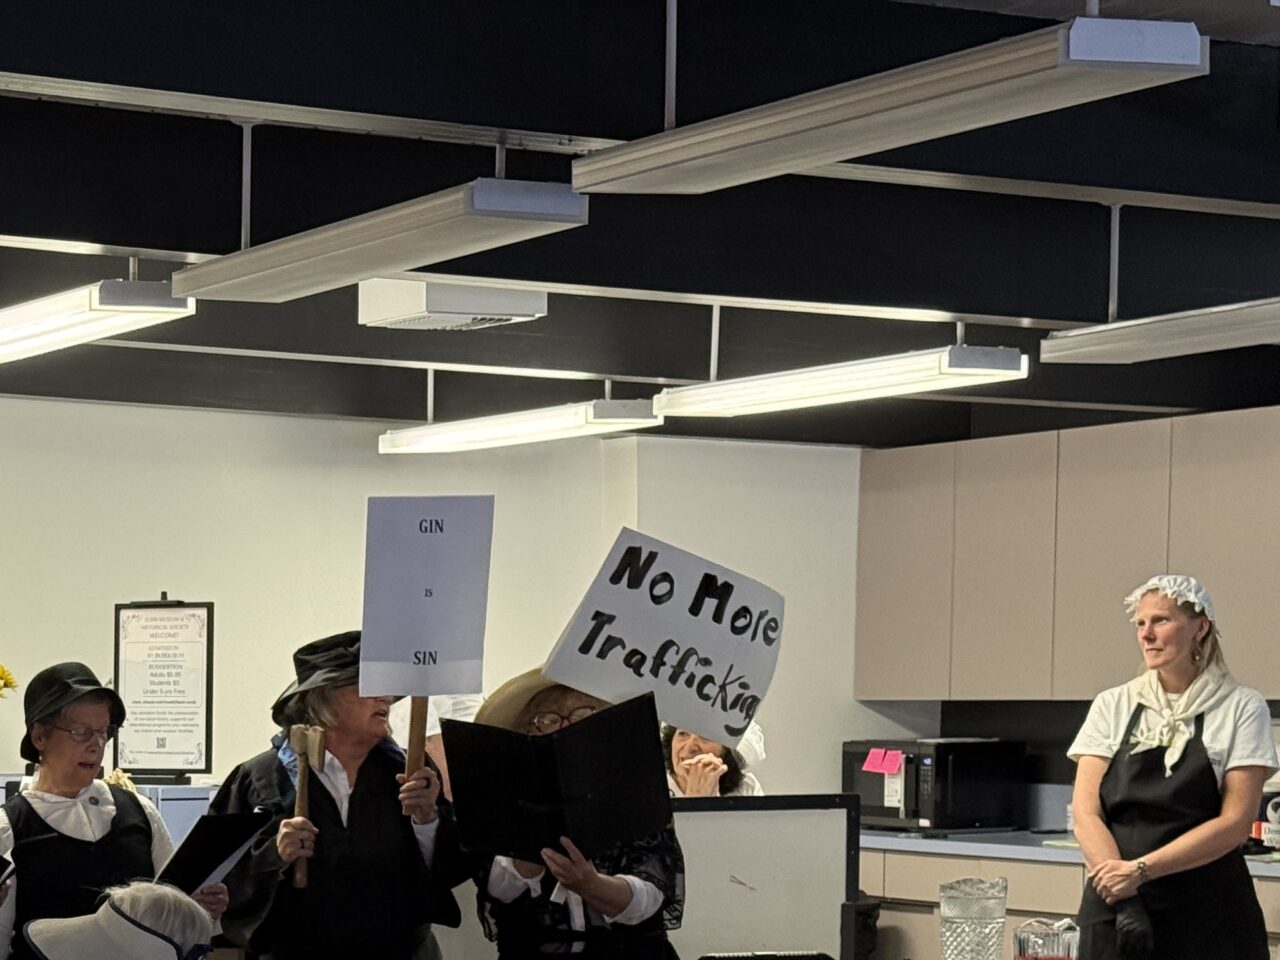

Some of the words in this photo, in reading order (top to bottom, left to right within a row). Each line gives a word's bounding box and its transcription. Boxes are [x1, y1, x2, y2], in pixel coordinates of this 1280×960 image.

[419, 519, 445, 533] GIN
[609, 546, 675, 606] No
[688, 572, 779, 646] More
[413, 651, 437, 665] SIN
